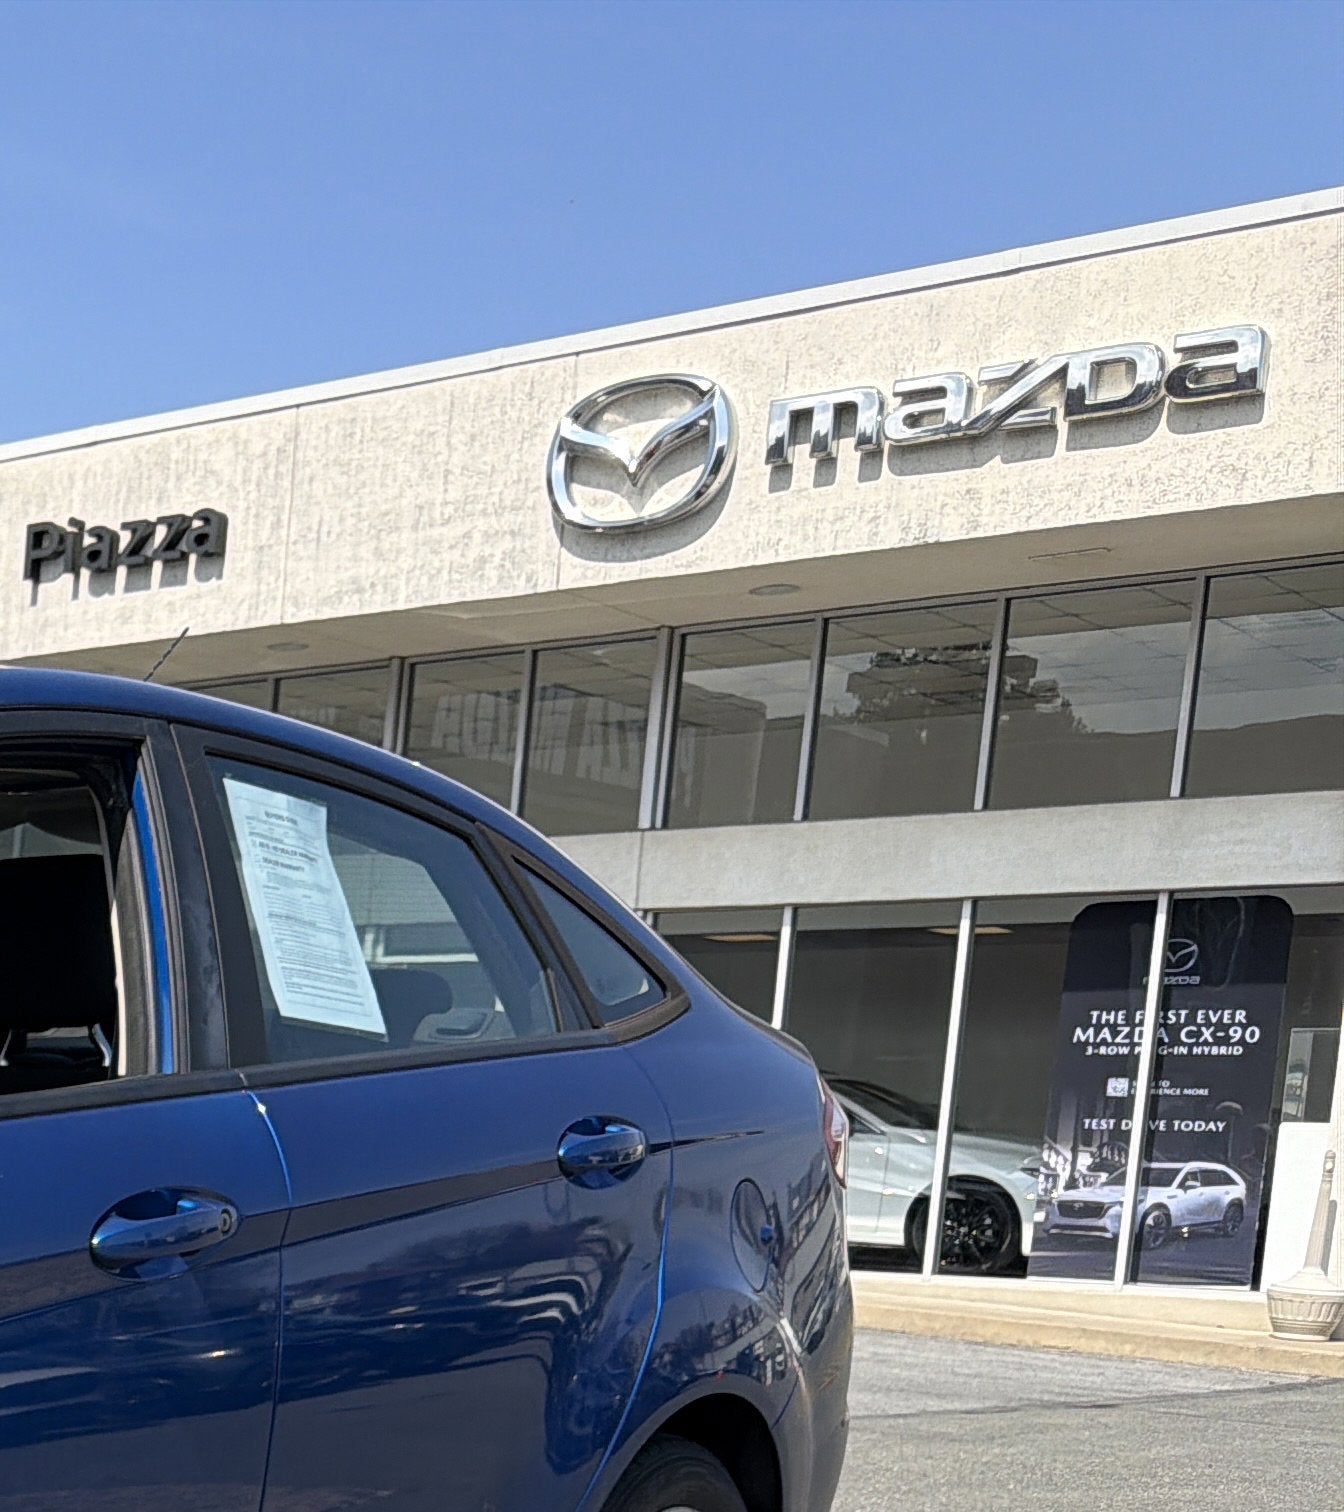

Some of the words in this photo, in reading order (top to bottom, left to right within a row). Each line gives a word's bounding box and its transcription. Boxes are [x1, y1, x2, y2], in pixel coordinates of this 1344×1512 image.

[764, 323, 1271, 465] mazda
[23, 507, 229, 583] Piazza
[1089, 1010, 1127, 1025] THE
[1196, 1009, 1248, 1024] EVER
[1180, 1025, 1261, 1044] CX-90
[1085, 1046, 1131, 1056] 3-ROW
[1134, 1045, 1189, 1056] PG-IN
[1192, 1045, 1244, 1056] HYBRID
[1182, 1088, 1210, 1096] MORE
[1083, 1118, 1117, 1131] TEST
[1121, 1119, 1167, 1132] DVE
[1173, 1119, 1227, 1132] TODAY
